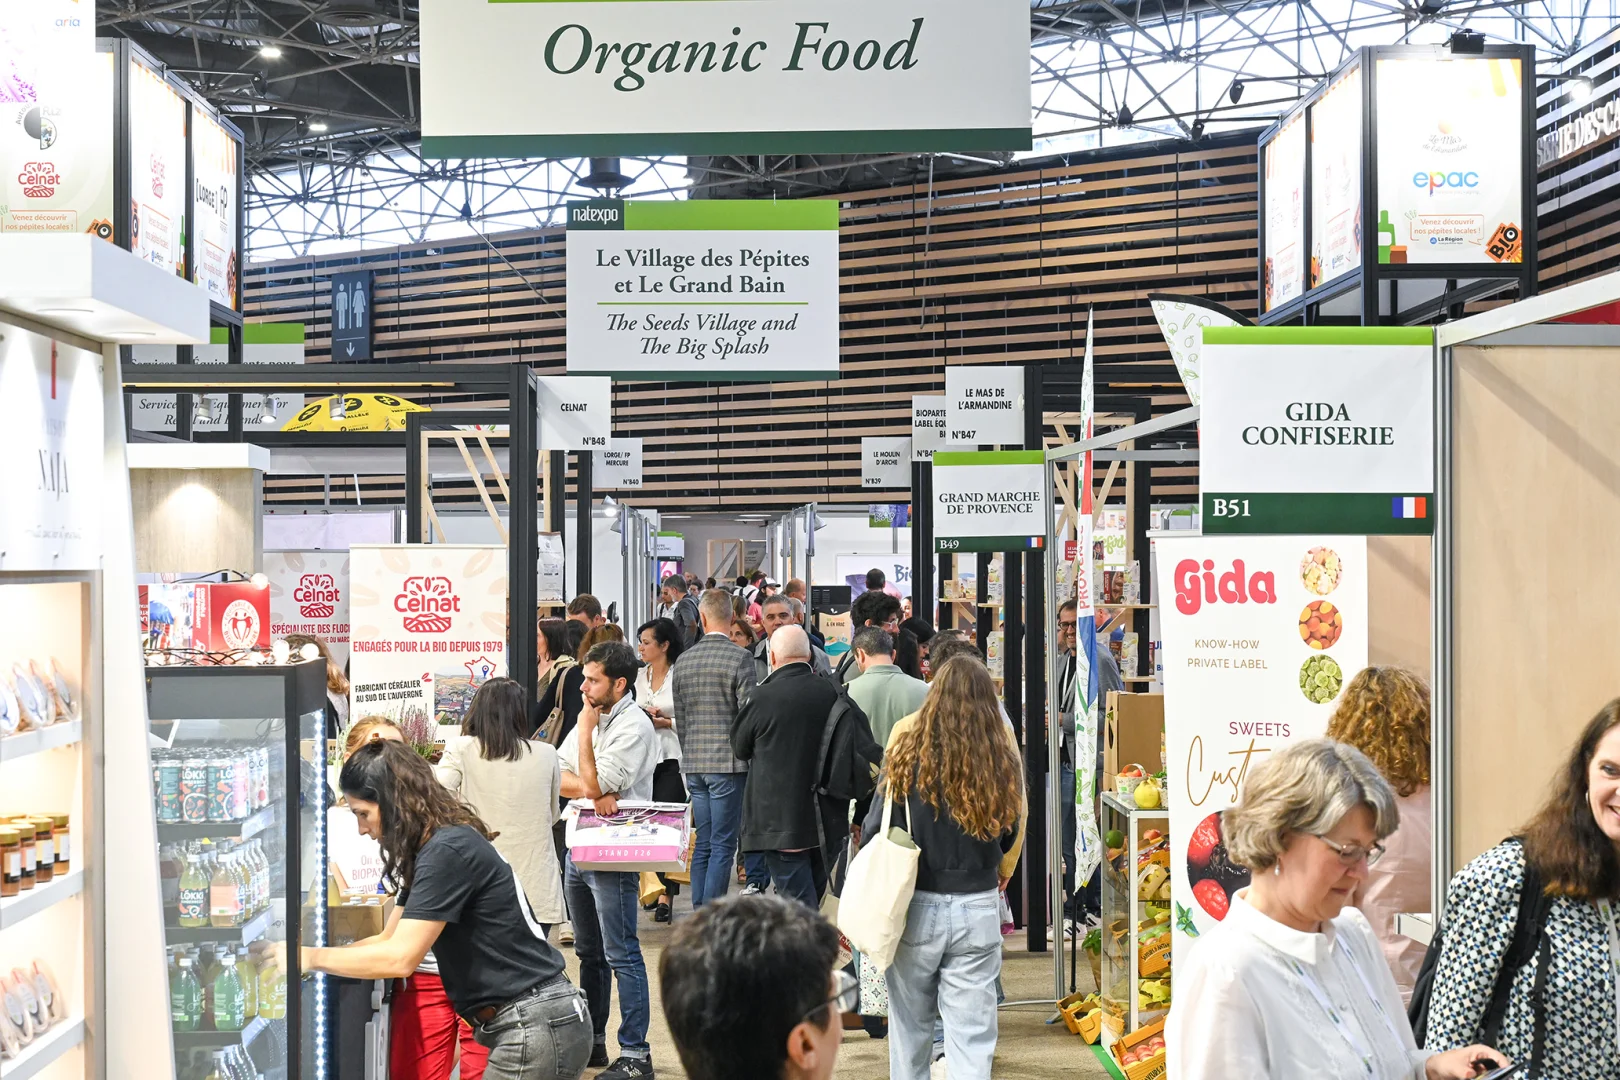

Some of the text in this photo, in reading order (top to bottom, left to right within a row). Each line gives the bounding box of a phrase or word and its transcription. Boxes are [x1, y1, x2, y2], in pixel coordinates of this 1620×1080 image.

[544, 17, 925, 92] Organic Food
[18, 173, 61, 185] Celnat
[1413, 171, 1479, 197] epac
[573, 206, 619, 225] natexpo
[19, 223, 45, 232] pépites
[1428, 227, 1453, 237] pépites
[1488, 227, 1519, 259] BIO
[596, 248, 810, 272] Le Village des Pépites
[614, 274, 785, 293] et Le Grand Bain
[607, 313, 798, 336] The Seeds Village and
[640, 337, 770, 360] The Big Splash
[966, 388, 1005, 397] LE MAS DE
[139, 398, 177, 410] Service
[560, 403, 588, 412] CELNAT
[958, 400, 1012, 410] L'ARMANDINE
[1285, 403, 1351, 422] GIDA
[914, 420, 934, 428] LABEL
[952, 430, 976, 440] N°B47
[1241, 426, 1394, 446] CONFISERIE
[582, 437, 606, 446] N°B48
[939, 491, 1041, 503] GRAND MARCHE
[946, 503, 1034, 515] DE PROVENCE
[1213, 499, 1252, 518] B51
[940, 539, 960, 549] B49
[294, 588, 341, 602] Celnat
[394, 594, 461, 612] Celnat
[272, 622, 316, 634] SPÉCIALISTE
[318, 624, 331, 634] DES
[353, 639, 503, 653] ENGAGÉS POUR LA BIO DEPUIS 1979
[1194, 639, 1260, 650] KNOW-HOW
[1187, 657, 1268, 669] PRIVATE LABEL
[355, 679, 421, 693] FABRICANT CÉRÉALIER
[355, 690, 423, 703] AU SUD DE L'AUVERGNE
[1229, 721, 1291, 738] SWEETS
[599, 849, 651, 857] STAND F26
